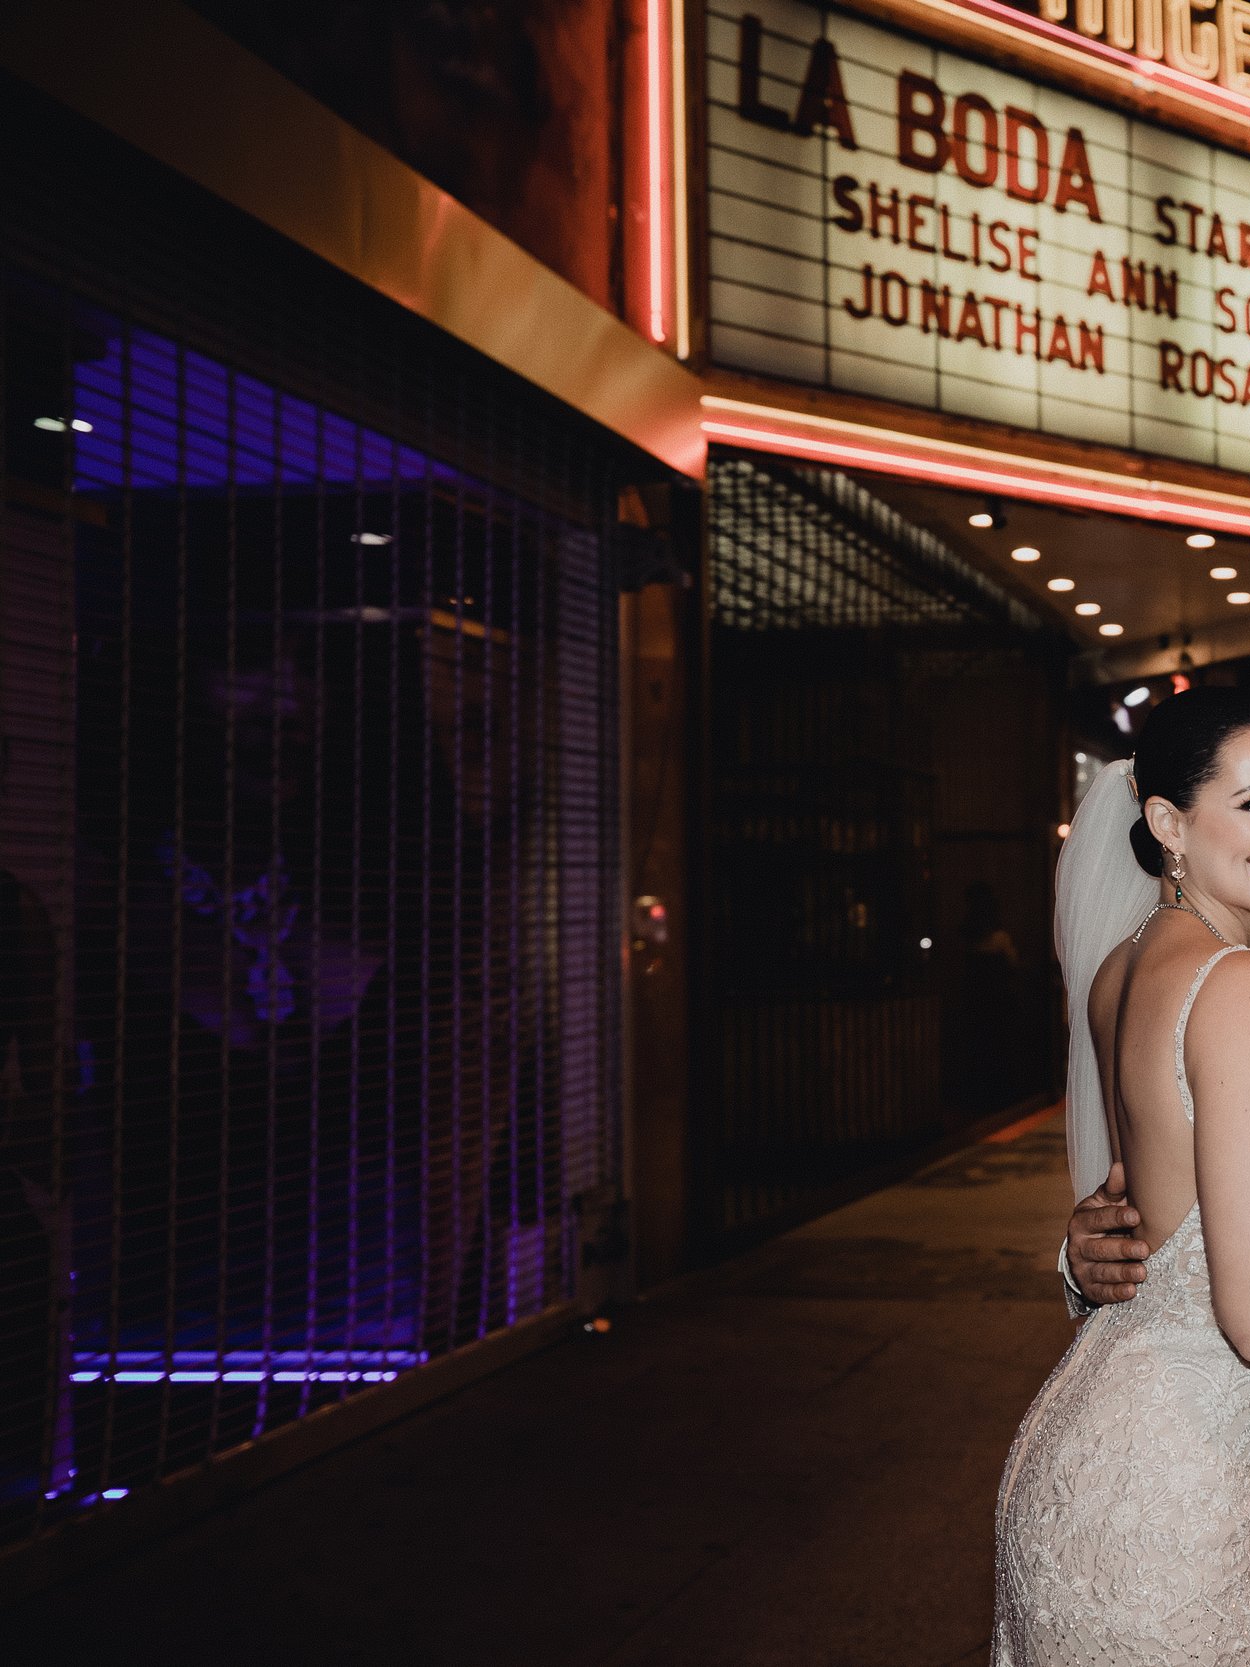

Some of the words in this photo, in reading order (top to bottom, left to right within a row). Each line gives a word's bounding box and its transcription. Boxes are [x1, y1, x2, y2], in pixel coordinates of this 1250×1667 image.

[738, 13, 857, 150] LA
[898, 68, 1102, 223] BODA
[831, 175, 1041, 282] SHELISE
[1087, 250, 1178, 320] ANN
[843, 264, 1104, 374] JONATHAN
